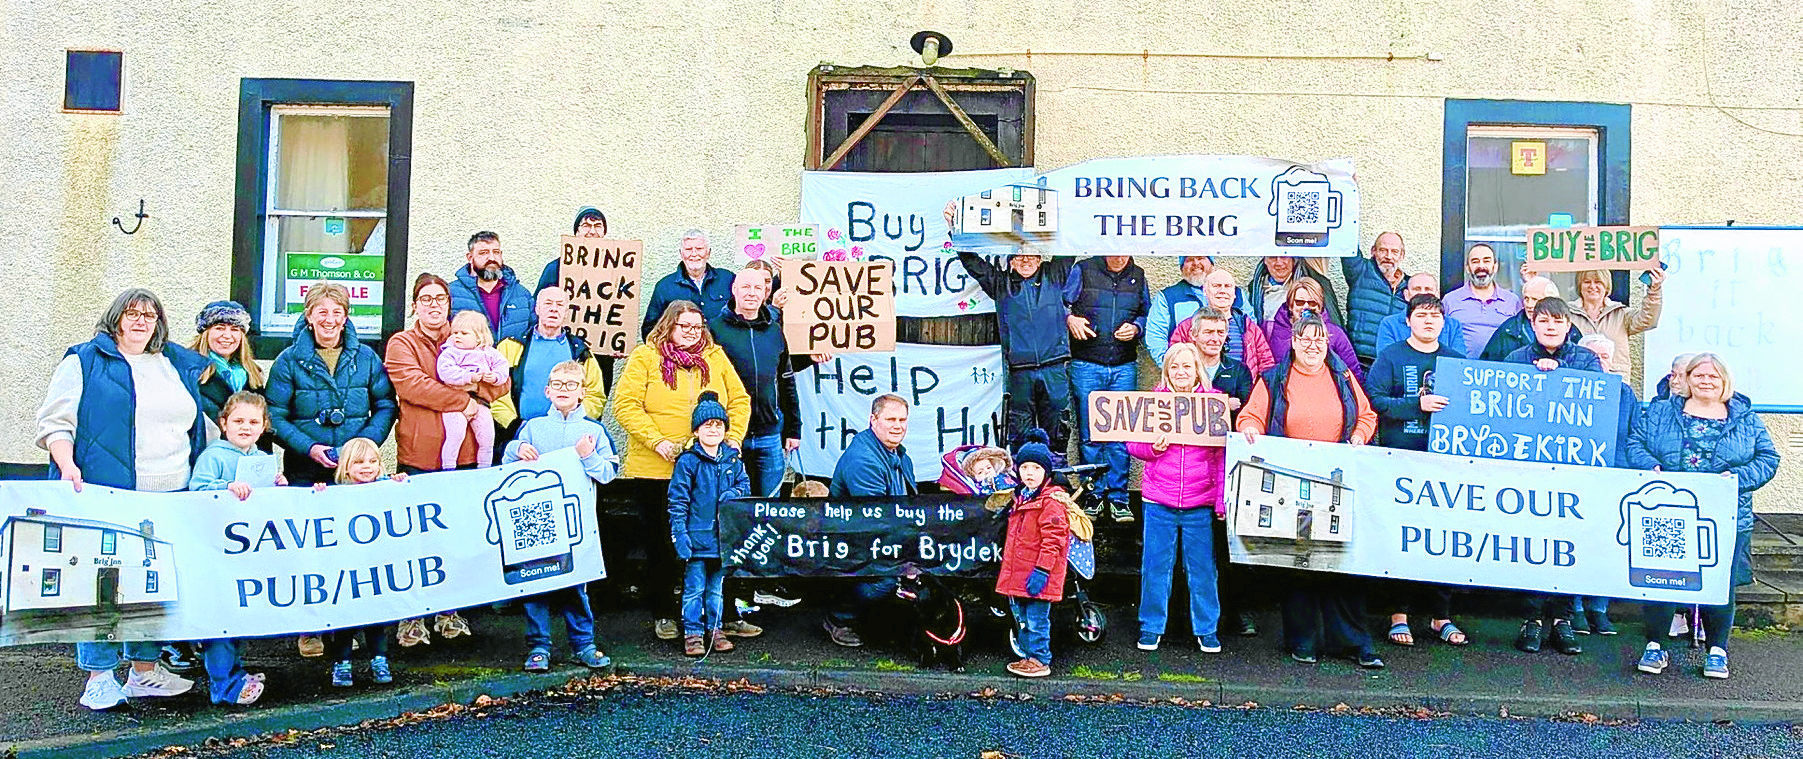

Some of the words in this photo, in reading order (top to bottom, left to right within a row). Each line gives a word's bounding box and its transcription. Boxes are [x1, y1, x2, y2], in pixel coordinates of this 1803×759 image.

[1074, 176, 1169, 199] BRING
[1179, 177, 1261, 199] BACK
[749, 228, 762, 240] I
[783, 227, 813, 237] THE
[847, 201, 925, 252] Buy
[1094, 214, 1157, 236] THE
[1166, 214, 1238, 236] BRIG
[781, 242, 816, 255] BRIG
[1286, 236, 1303, 245] Scan
[1304, 236, 1317, 245] me!
[1533, 230, 1582, 262] BUY
[1584, 234, 1595, 260] THE
[1599, 230, 1658, 262] BRIG
[563, 243, 637, 269] BRING
[290, 268, 298, 277] G
[300, 268, 308, 277] M
[311, 268, 351, 278] Thomson
[353, 269, 361, 278] &
[363, 270, 376, 279] Co
[795, 262, 886, 296] SAVE
[563, 275, 636, 301] BACK
[568, 303, 626, 327] THE
[813, 295, 880, 321] OUR
[809, 322, 877, 351] PUB
[814, 356, 940, 406] Help
[1462, 366, 1548, 392] SUPPORT
[1562, 375, 1607, 400] THE
[1093, 395, 1156, 433] SAVE
[1157, 399, 1173, 433] OUR
[1174, 395, 1230, 437] PUB
[1470, 389, 1534, 419] BRIG
[1547, 401, 1593, 427] INN
[1394, 476, 1486, 512] SAVE
[1495, 486, 1585, 520] OUR
[754, 502, 806, 519] Please
[824, 502, 853, 521] help
[863, 505, 882, 519] us
[895, 504, 926, 526] buy
[937, 504, 964, 521] the
[224, 516, 338, 555] SAVE
[348, 502, 449, 544] OUR
[730, 523, 767, 566] thank
[752, 522, 782, 566] you!
[787, 533, 849, 560] Brig
[870, 537, 903, 560] for
[1400, 525, 1577, 567] PUB/HUB
[236, 555, 447, 608] PUB/HUB
[519, 567, 542, 579] Scan
[543, 562, 560, 577] me!
[1645, 574, 1668, 586] Scan
[1669, 576, 1686, 587] me!
